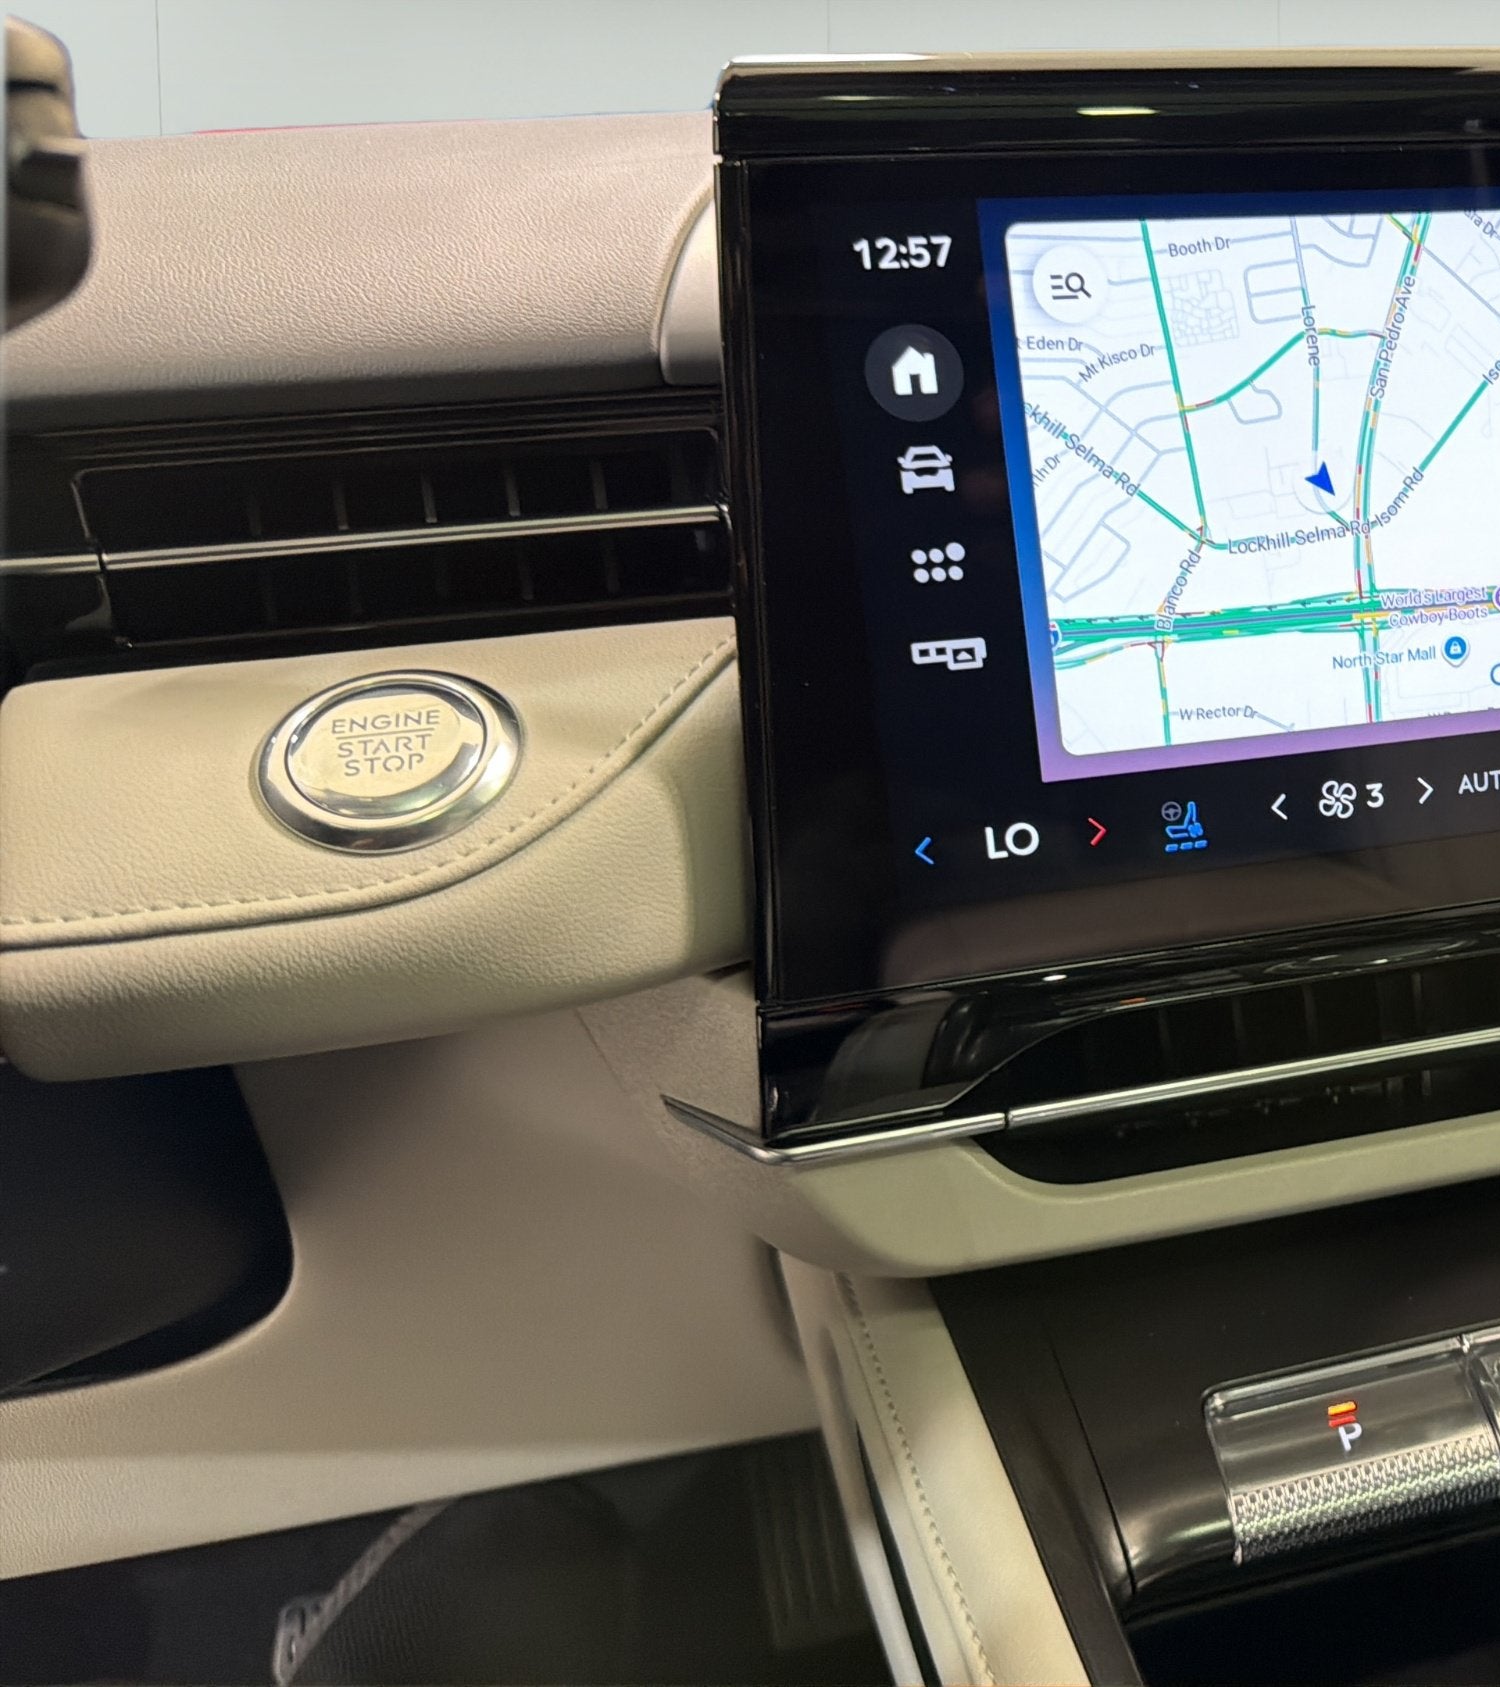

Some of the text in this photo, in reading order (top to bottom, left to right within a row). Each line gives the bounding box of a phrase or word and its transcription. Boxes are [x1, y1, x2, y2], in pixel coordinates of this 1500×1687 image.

[1483, 221, 1497, 238] Dr
[853, 235, 952, 270] 12:57
[1168, 236, 1231, 258] Booth Dr
[1026, 335, 1064, 350] Eden
[1068, 337, 1083, 351] Dr
[1301, 305, 1320, 366] Lorene
[1369, 275, 1416, 400] San Pedro Ave
[1078, 343, 1156, 382] Mt Kisco Dr
[1044, 454, 1061, 470] Dr
[1065, 434, 1114, 479] Selma
[1115, 472, 1141, 496] Rd
[1375, 467, 1425, 527] Isom Rd
[1228, 520, 1371, 554] Lockhill Selma Rd
[1157, 549, 1202, 631] Blanco Rd
[1381, 587, 1487, 608] World's Largest
[1389, 606, 1488, 627] Cowboy Boots
[1333, 645, 1436, 670] North Star Mall
[331, 709, 440, 734] ENGINE
[1179, 704, 1258, 721] W Rector Dr
[337, 734, 432, 758] START
[344, 753, 424, 777] STOP
[1366, 783, 1384, 808] 3
[985, 822, 1039, 859] LO
[1338, 1422, 1362, 1453] P
